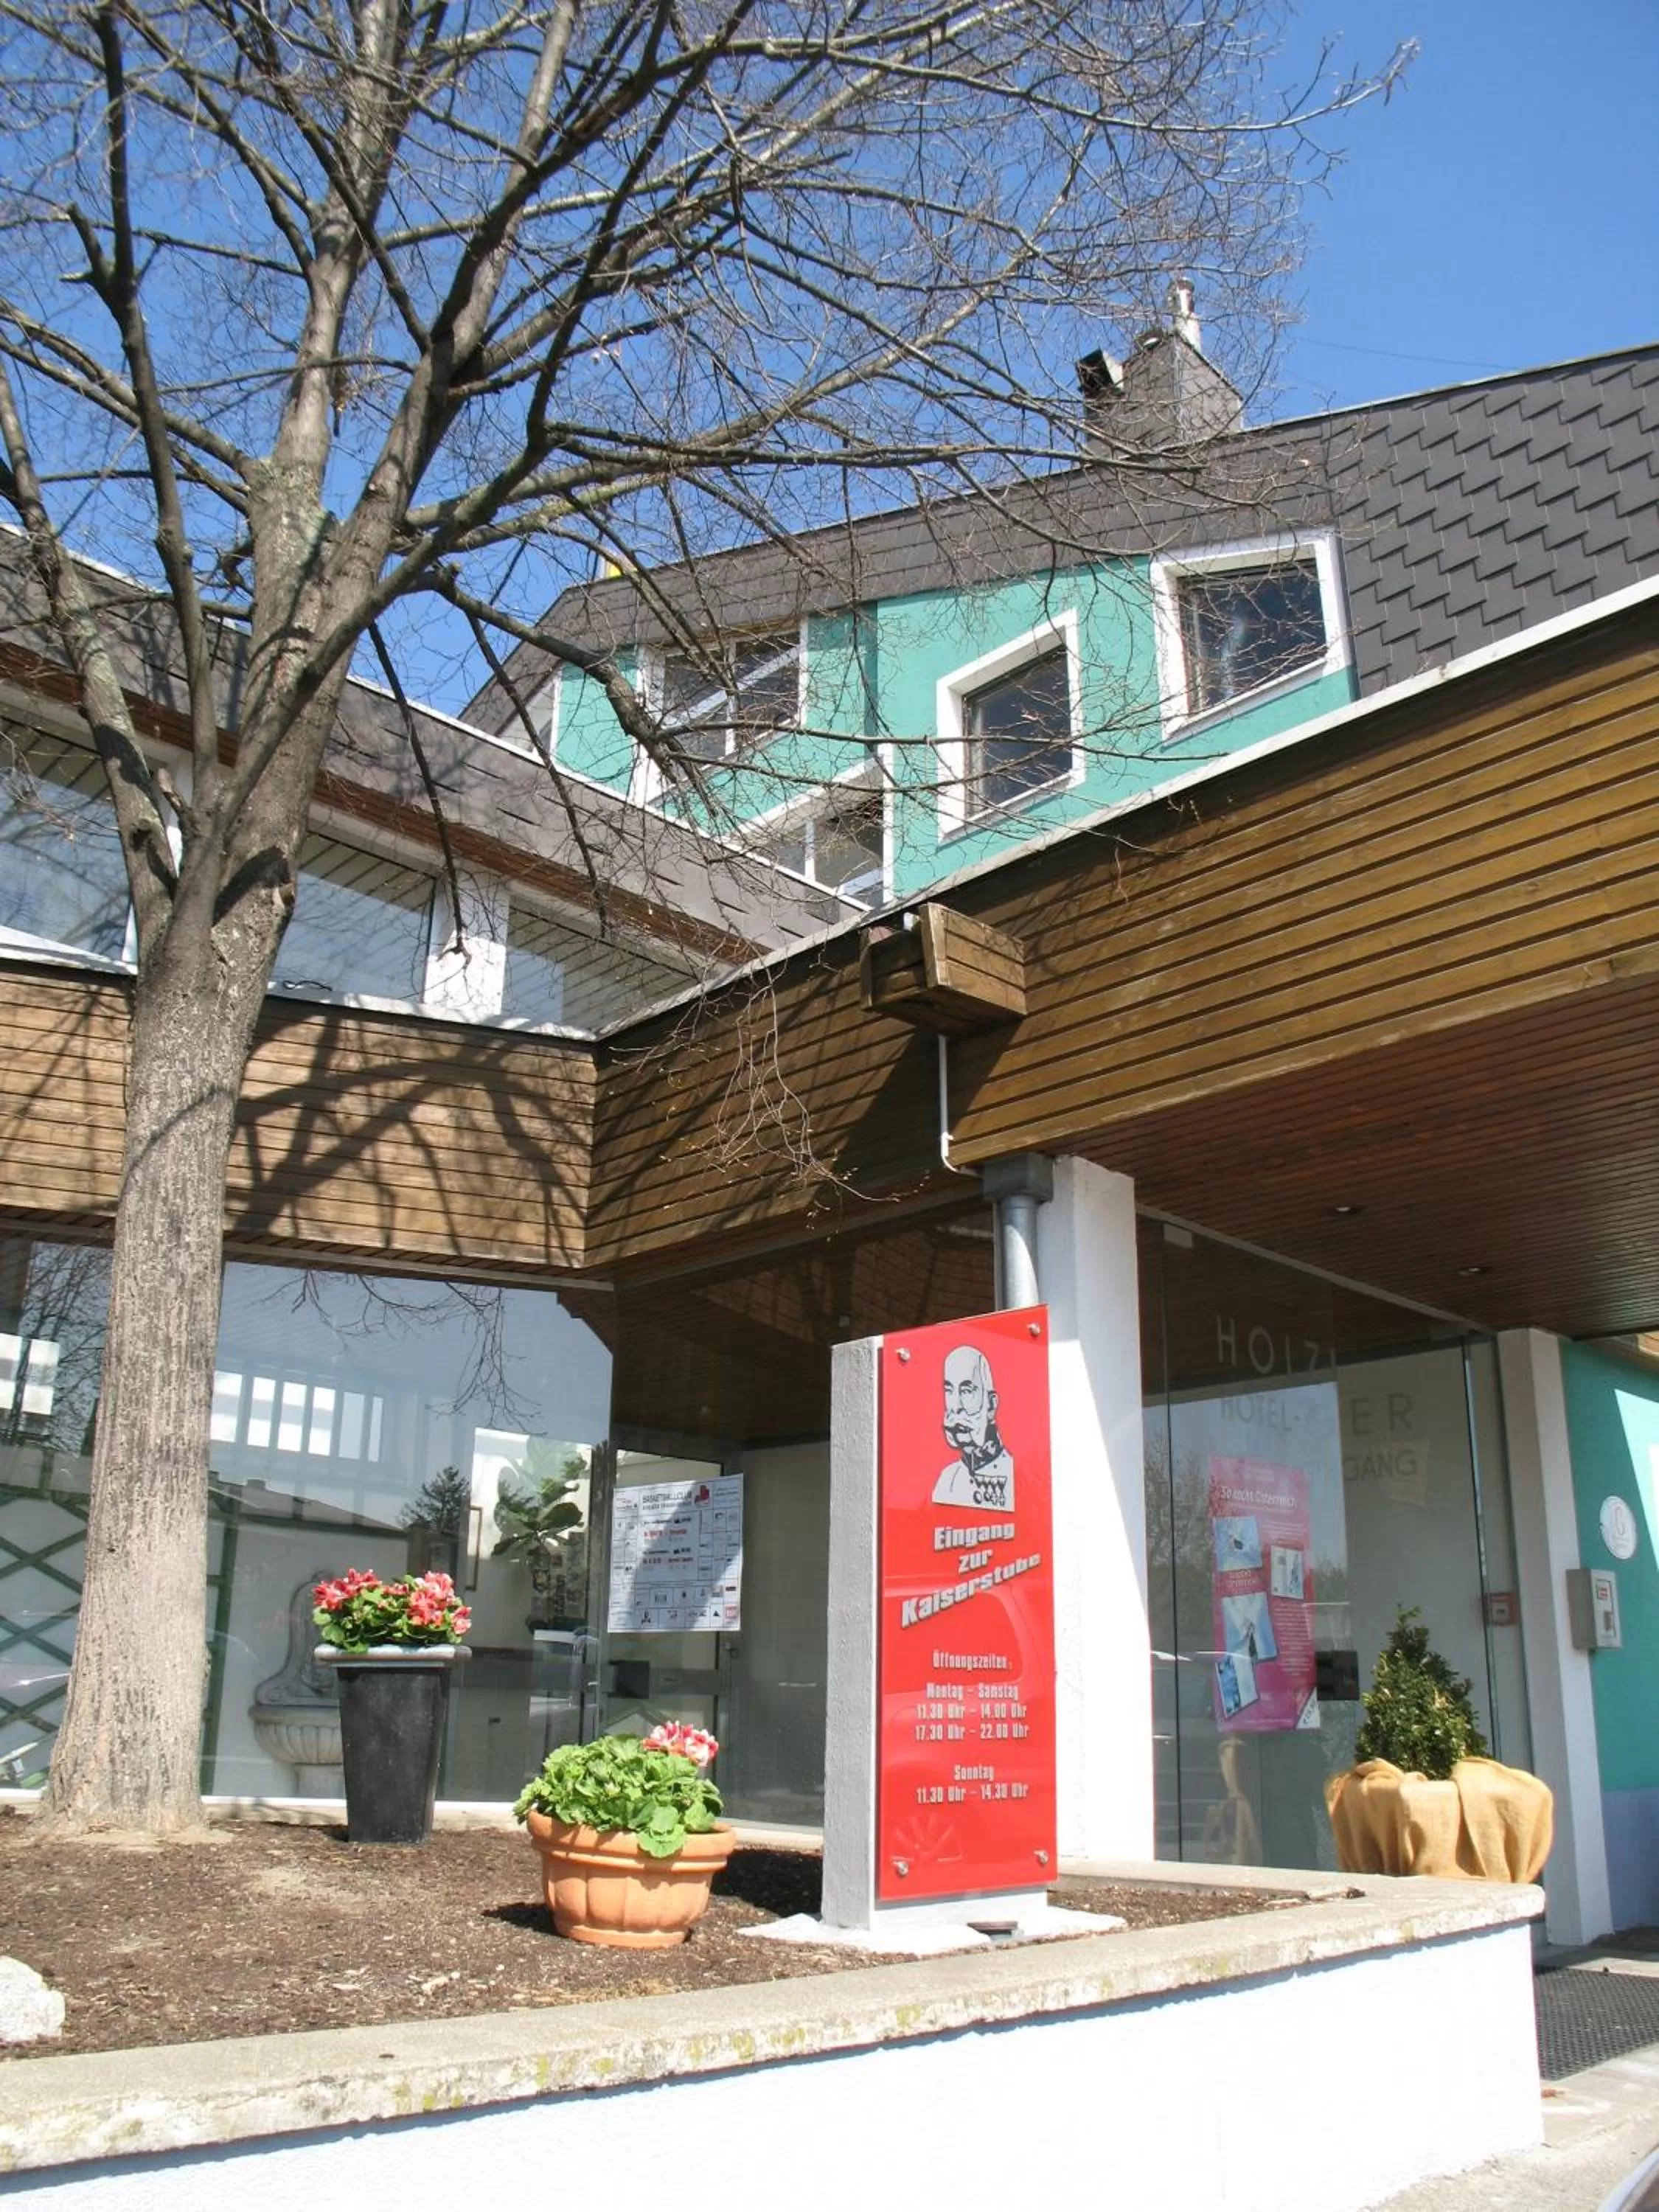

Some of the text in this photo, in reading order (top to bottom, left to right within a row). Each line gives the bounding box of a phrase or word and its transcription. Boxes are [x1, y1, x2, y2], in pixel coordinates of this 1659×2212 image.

[933, 1523, 1015, 1551] Eingang
[959, 1549, 993, 1573] zur
[901, 1554, 1041, 1628] Kaiserstube
[926, 1683, 964, 1700] Montag
[978, 1683, 1019, 1701] Samstag
[917, 1704, 944, 1719] 11.30
[947, 1703, 965, 1719] Uhr
[981, 1703, 1006, 1719] 14.00
[1011, 1703, 1027, 1718] Uhr
[915, 1725, 944, 1741] 17.30
[947, 1725, 965, 1740] Uhr
[980, 1724, 1008, 1739] 22.00
[1012, 1723, 1029, 1739] Uhr
[954, 1764, 995, 1781] Sonntag
[917, 1787, 944, 1804] 11.30
[947, 1786, 966, 1802] Uhr
[981, 1784, 1007, 1800] 14.30
[1012, 1783, 1028, 1798] Uhr
